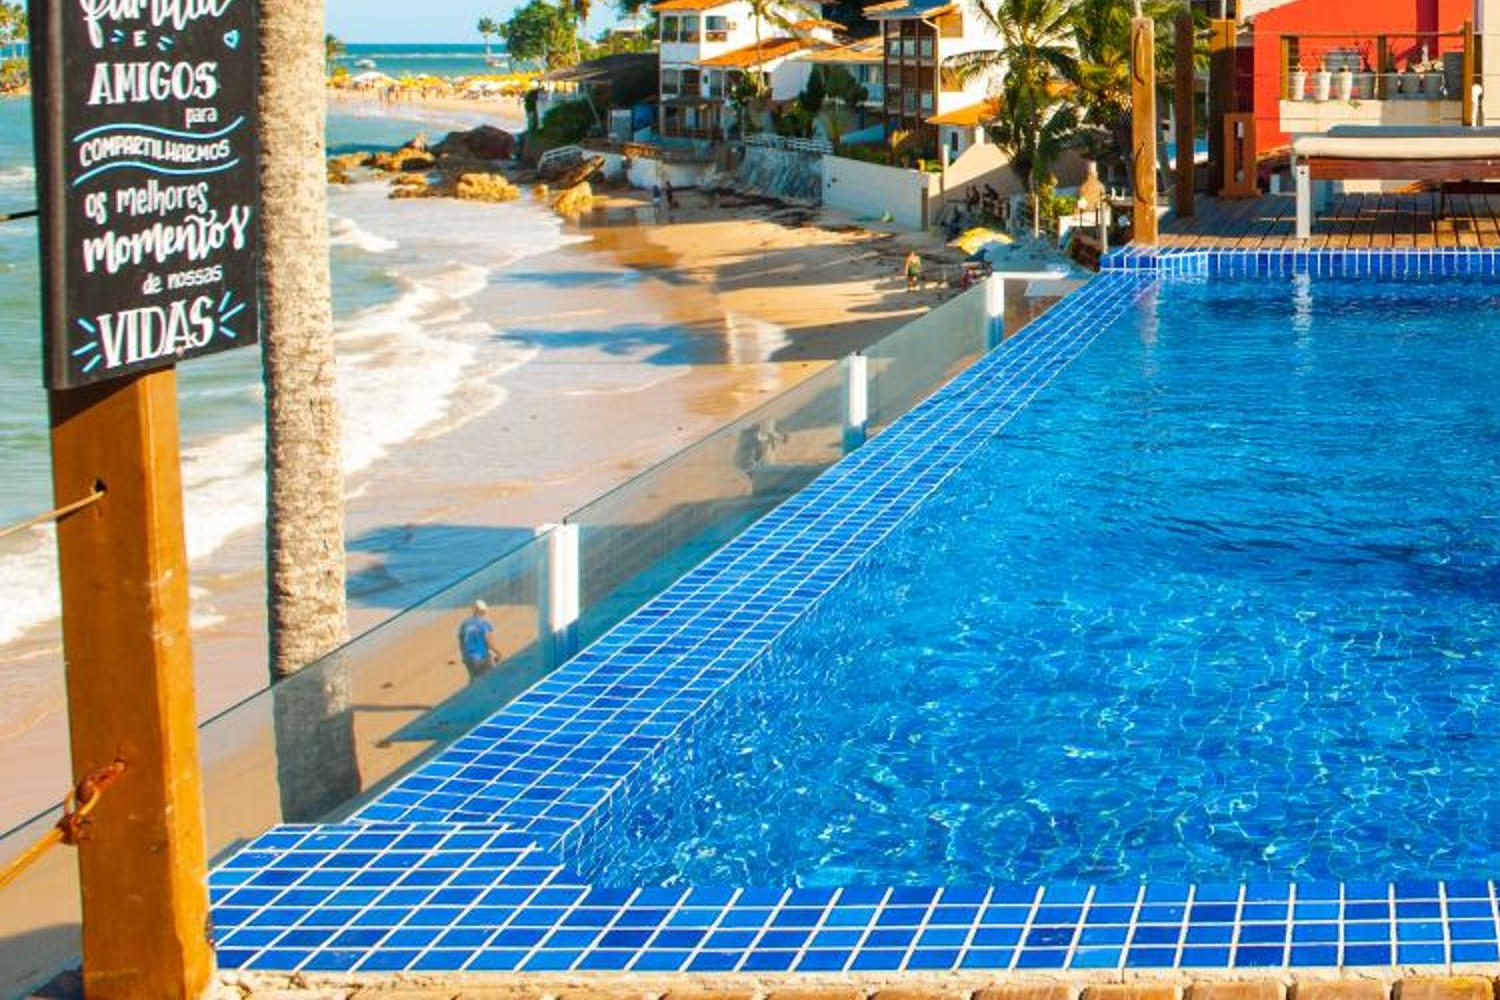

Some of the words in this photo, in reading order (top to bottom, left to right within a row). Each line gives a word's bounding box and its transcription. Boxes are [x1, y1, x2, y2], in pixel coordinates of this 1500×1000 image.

[133, 30, 147, 46] E
[87, 61, 218, 105] AMIGOS
[185, 107, 218, 129] para
[79, 135, 231, 167] COMPARTILHARMOS
[85, 191, 107, 224] os
[116, 179, 208, 216] melhores
[83, 205, 250, 273] momentos
[142, 273, 162, 295] de
[168, 264, 223, 288] nossas
[96, 295, 214, 368] VIDAS
